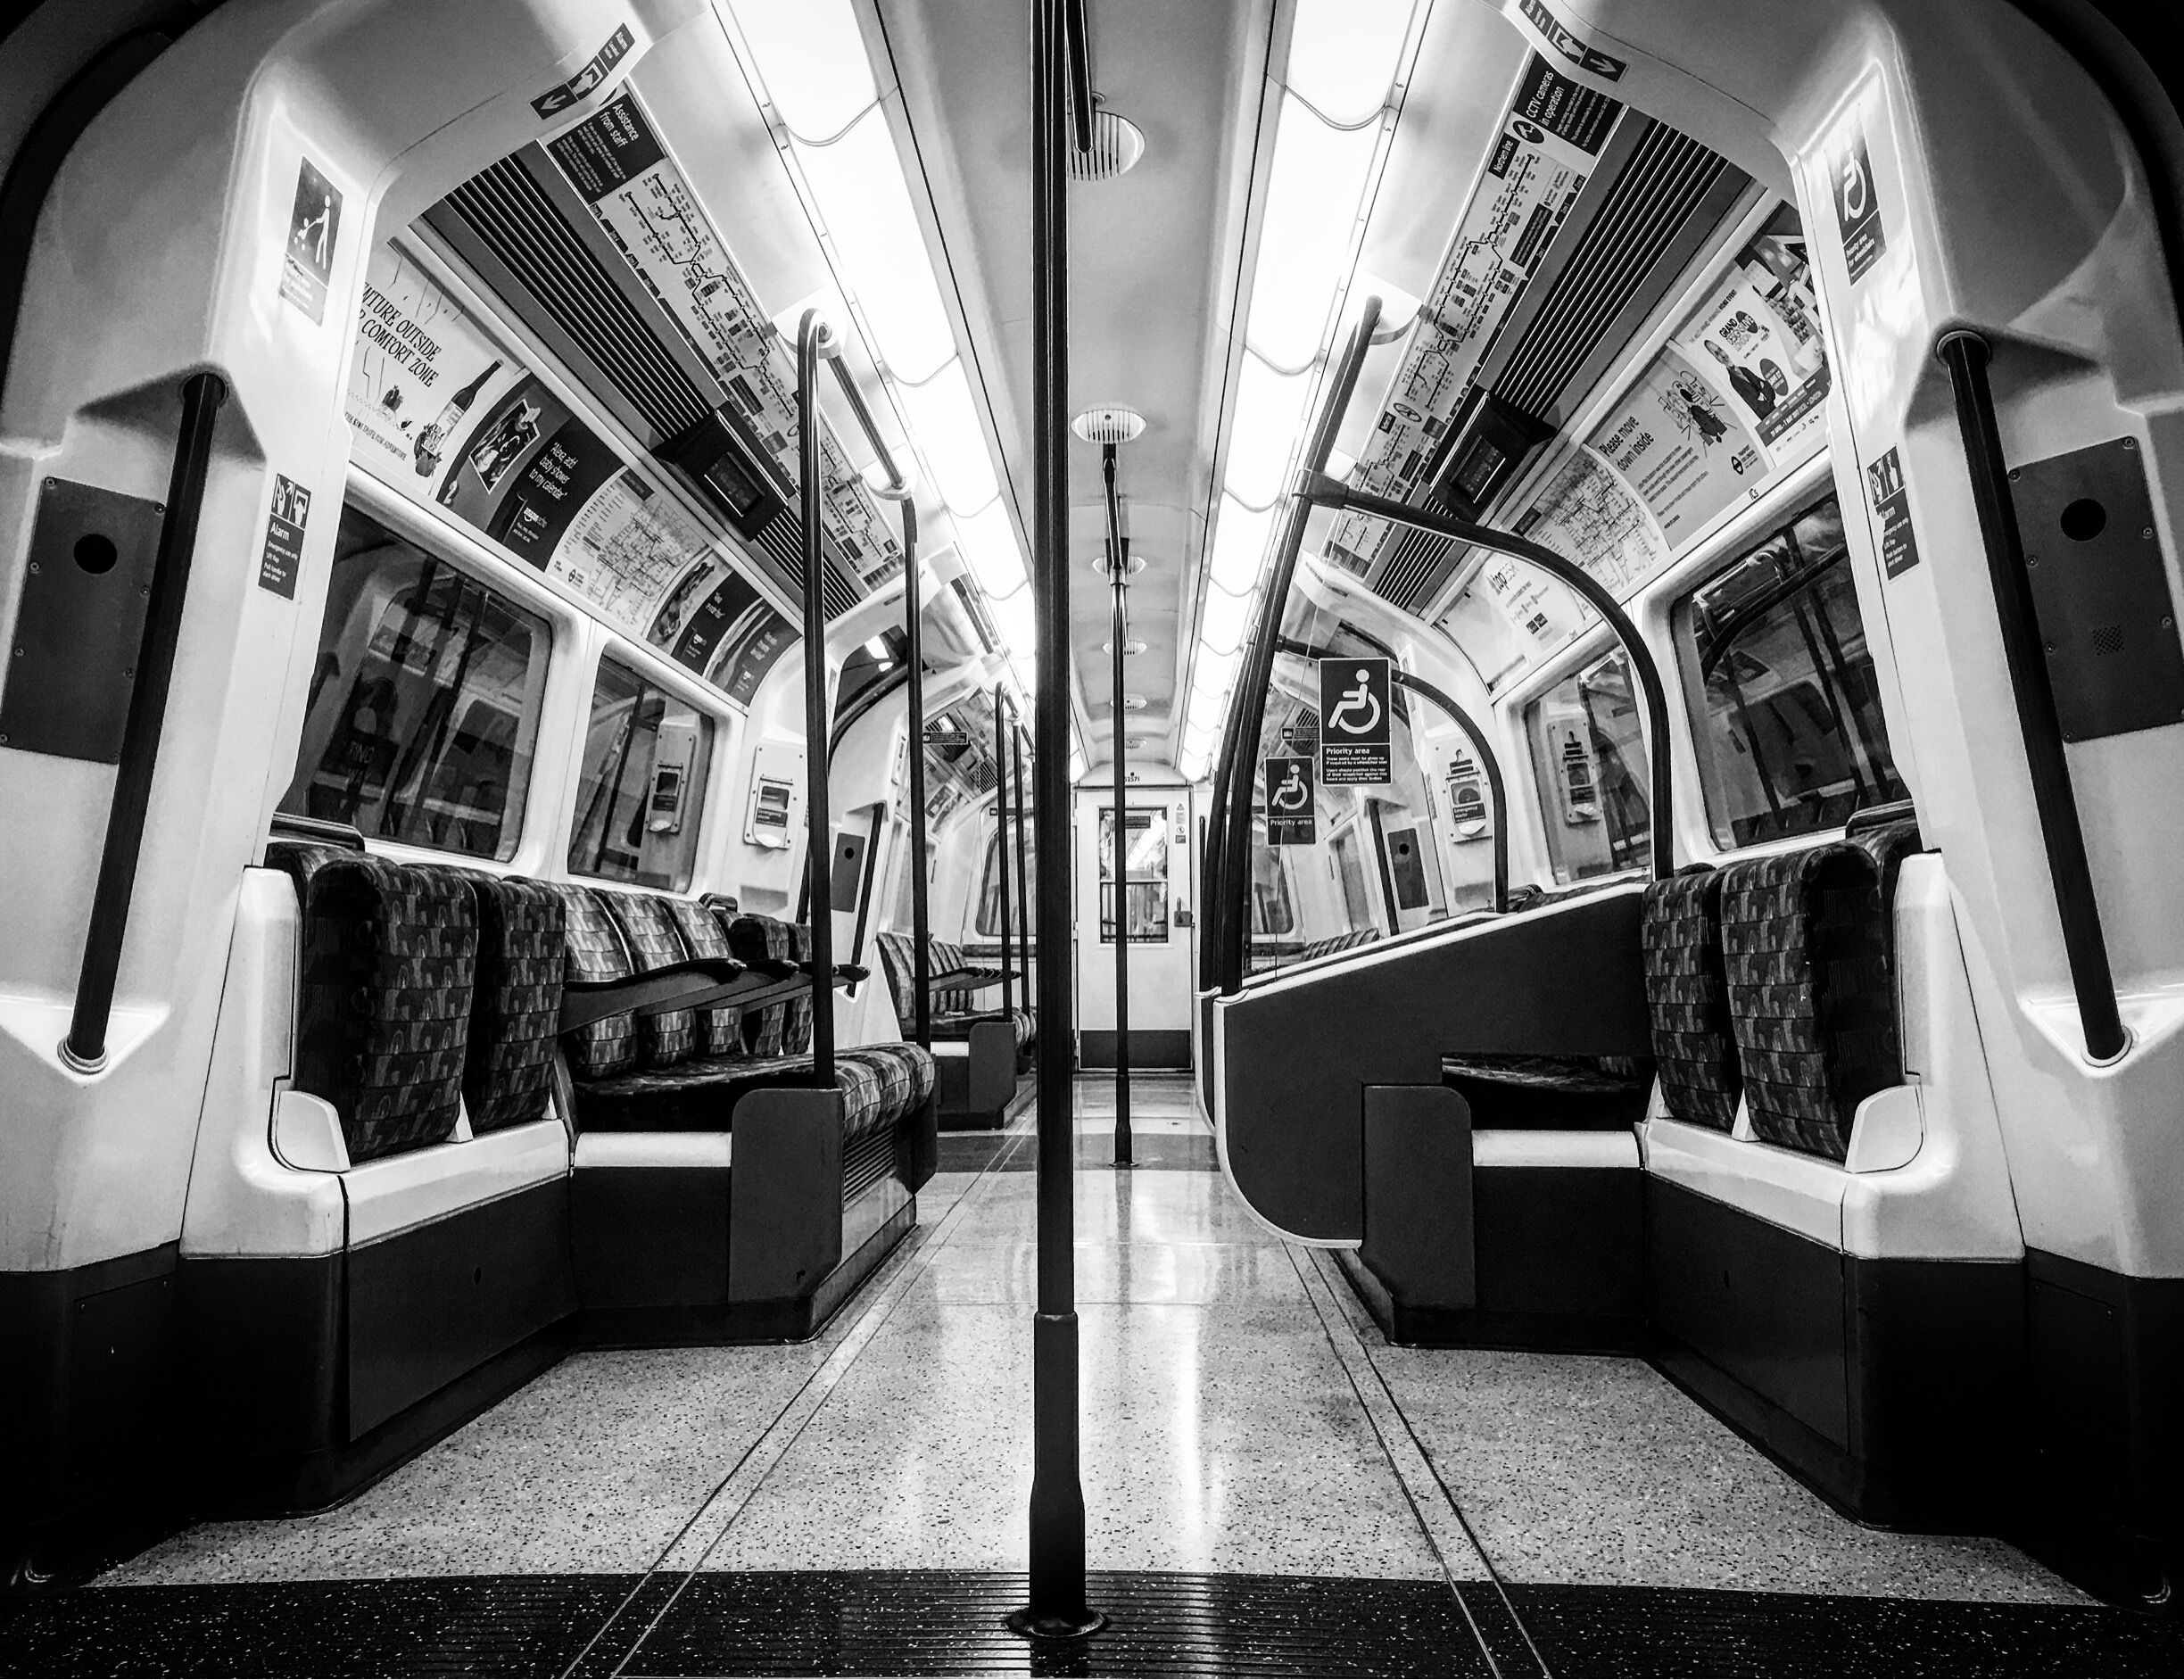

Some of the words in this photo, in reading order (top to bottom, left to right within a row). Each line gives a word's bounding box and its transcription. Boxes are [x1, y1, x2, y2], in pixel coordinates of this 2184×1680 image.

[1526, 96, 1541, 118] CCTV
[1536, 70, 1554, 100] cameras
[1544, 87, 1564, 119] operation
[600, 112, 615, 131] from
[610, 130, 628, 147] staff
[612, 103, 639, 141] Assistance
[1539, 118, 1550, 126] in
[1719, 319, 1738, 338] GRAND
[1740, 313, 1755, 330] LIVE
[361, 319, 415, 364] COMFORT
[408, 358, 439, 387] ZONE
[396, 319, 442, 362] OUTSIDE
[1598, 434, 1624, 458] Please
[1617, 417, 1639, 438] move
[1616, 451, 1637, 471] down
[1629, 433, 1654, 456] inside
[539, 455, 554, 473] baby
[550, 466, 570, 484] shower
[563, 457, 578, 468] add
[529, 468, 538, 479] to
[534, 474, 545, 487] my
[270, 522, 289, 541] Alarm
[1326, 747, 1353, 755] Priority
[1270, 818, 1296, 826] Priority
